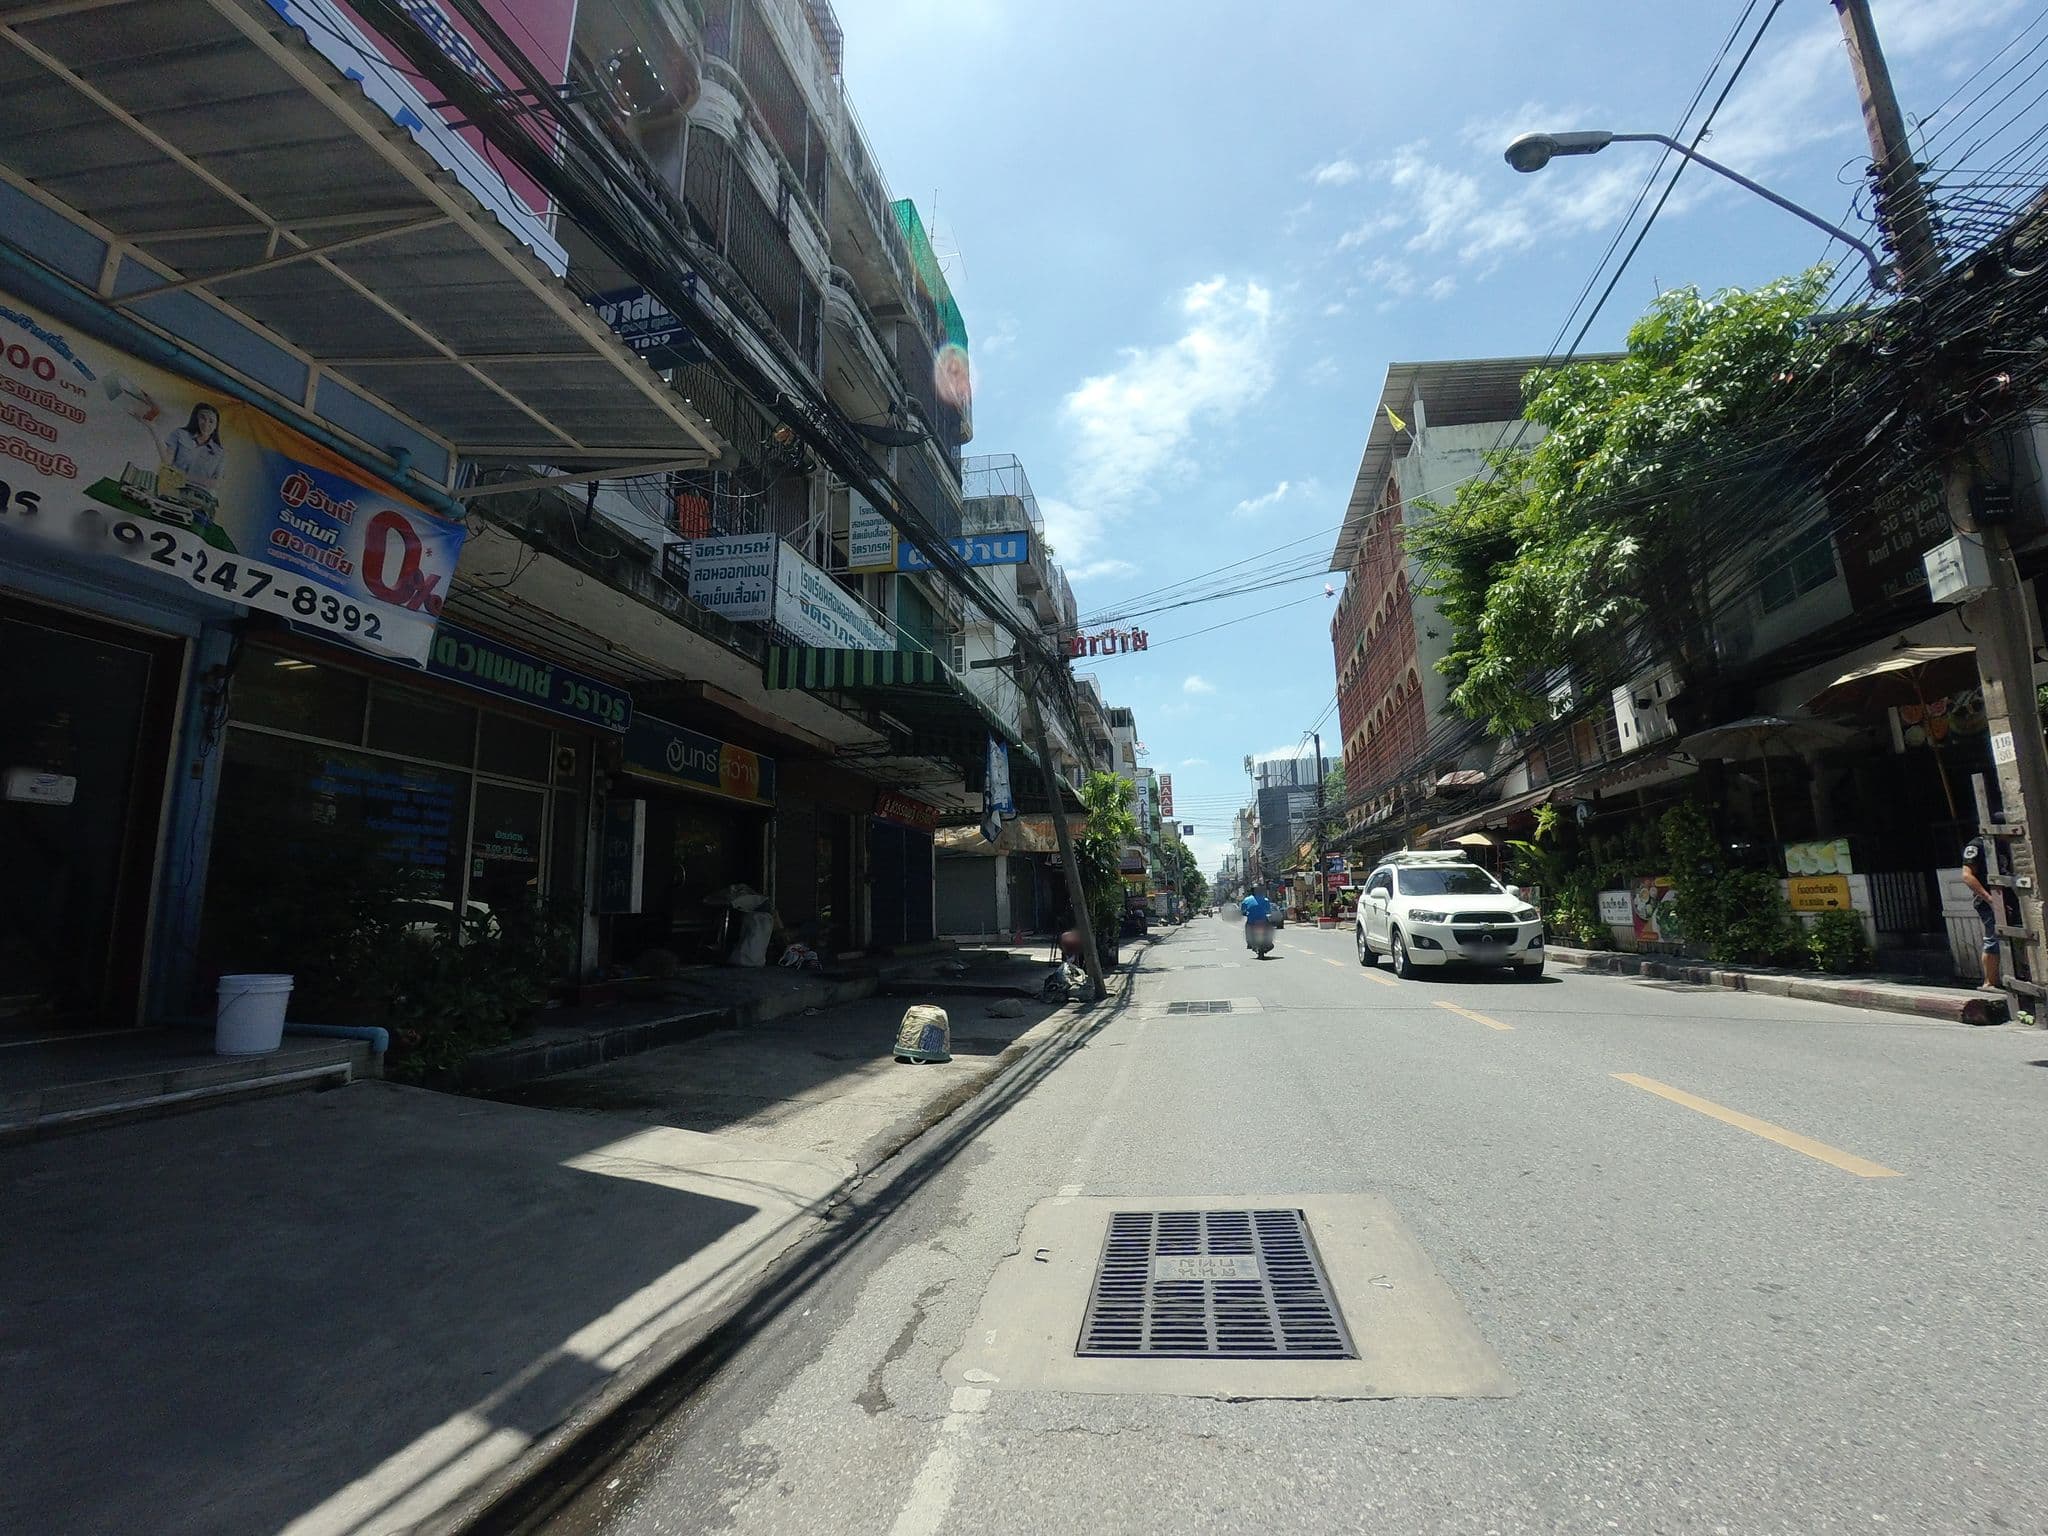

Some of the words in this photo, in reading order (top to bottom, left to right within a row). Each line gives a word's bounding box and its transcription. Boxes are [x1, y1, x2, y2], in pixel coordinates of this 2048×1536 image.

[0, 338, 56, 382] 00
[0, 377, 87, 424] รมเนียม
[280, 469, 357, 526] กู้วันนี้
[277, 508, 340, 547] รับทันที
[695, 537, 771, 558] จิตราภรณ์
[270, 528, 355, 573] ดอกเบี้ย
[694, 564, 770, 582] สอนออกแบบ
[436, 635, 553, 700] ตวแพทย์
[1160, 775, 1172, 816] BAAC
